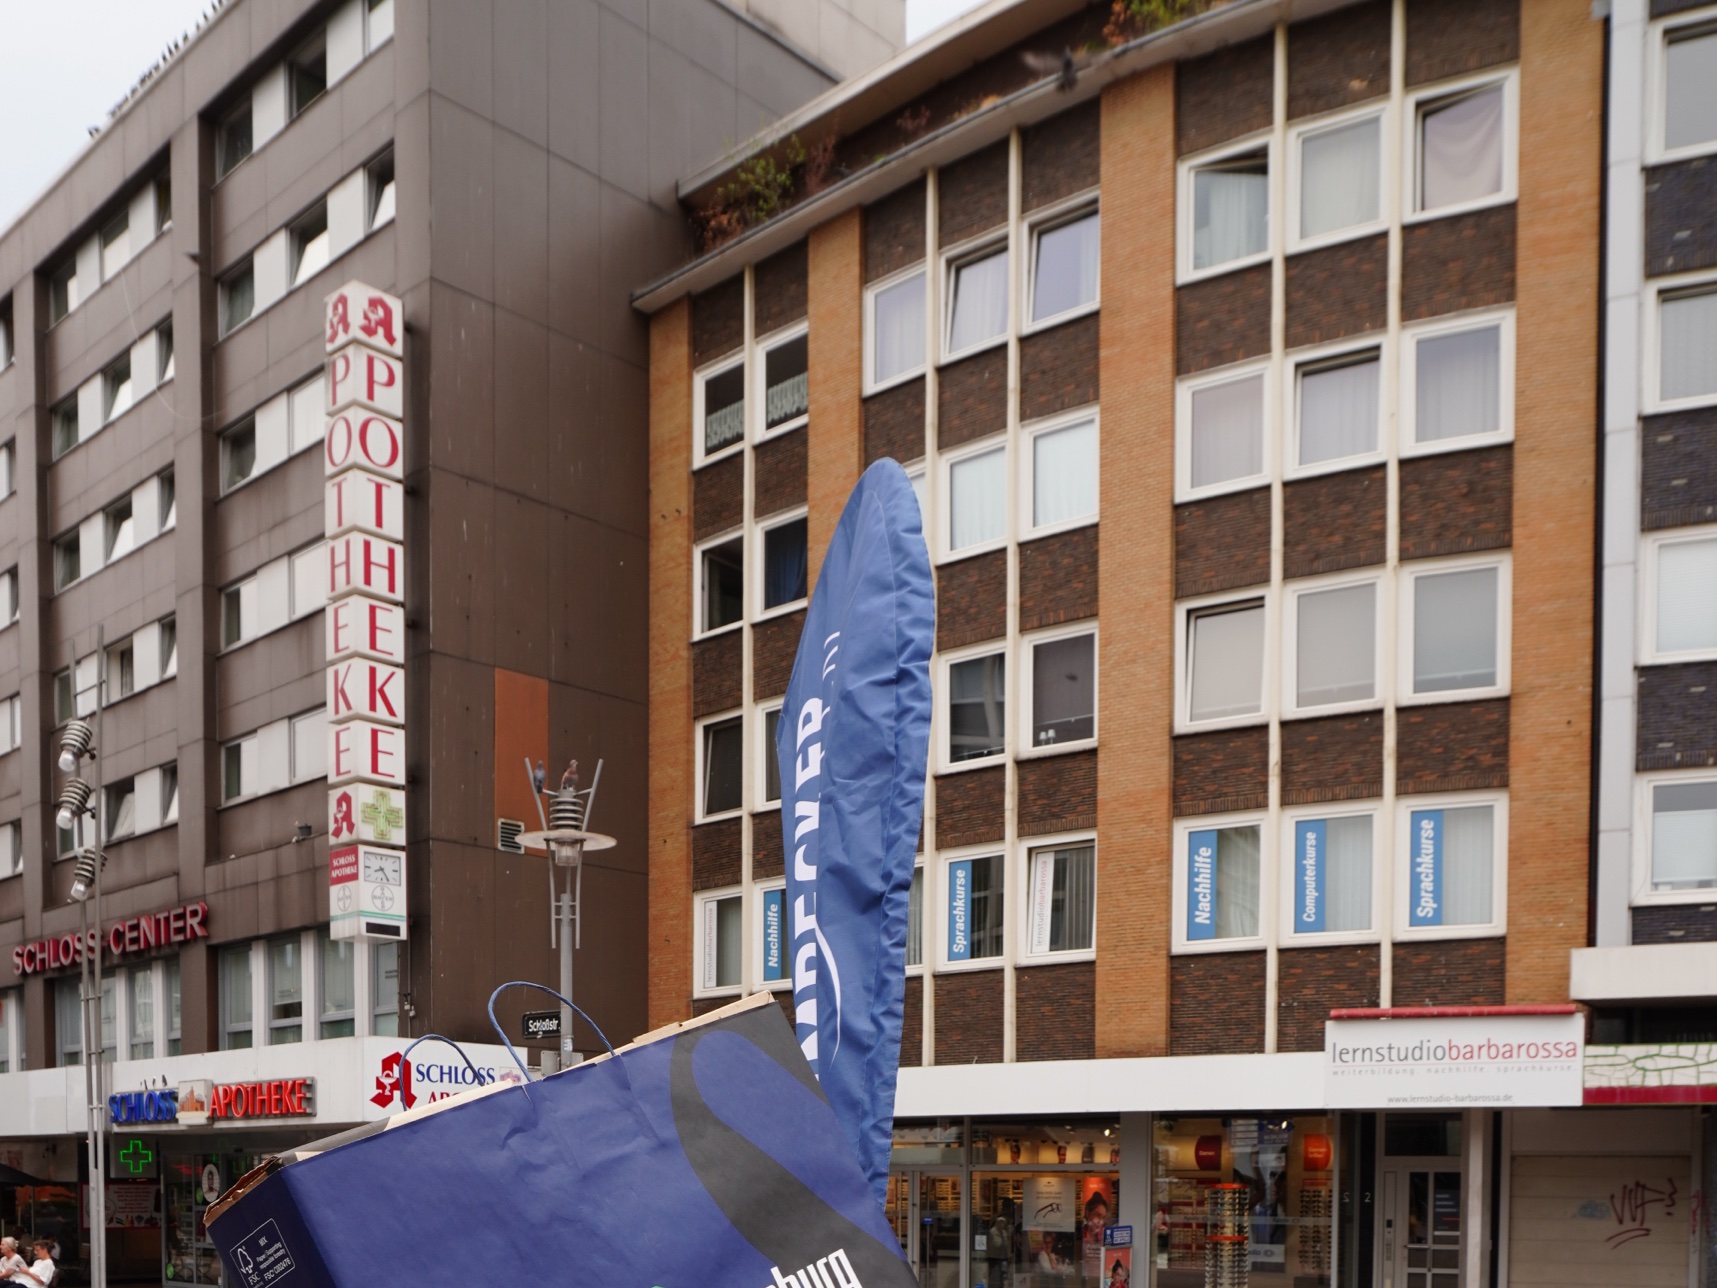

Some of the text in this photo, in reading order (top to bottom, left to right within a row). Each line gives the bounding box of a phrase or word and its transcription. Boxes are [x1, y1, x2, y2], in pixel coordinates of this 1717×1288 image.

[327, 294, 352, 777] APOTHEKE
[358, 296, 400, 778] APOTHEKE
[1194, 847, 1211, 924] Nachhilfe
[1303, 832, 1318, 922] Computerkurse
[1416, 819, 1434, 918] Sprachkurse
[767, 904, 779, 967] Nachhilfe
[953, 869, 966, 953] Sprachkurse
[416, 1063, 496, 1085] SCHLOSS
[1332, 1038, 1577, 1064] lernstudiobarbarossa
[109, 1079, 307, 1124] SCHLOSS APOTHEKE
